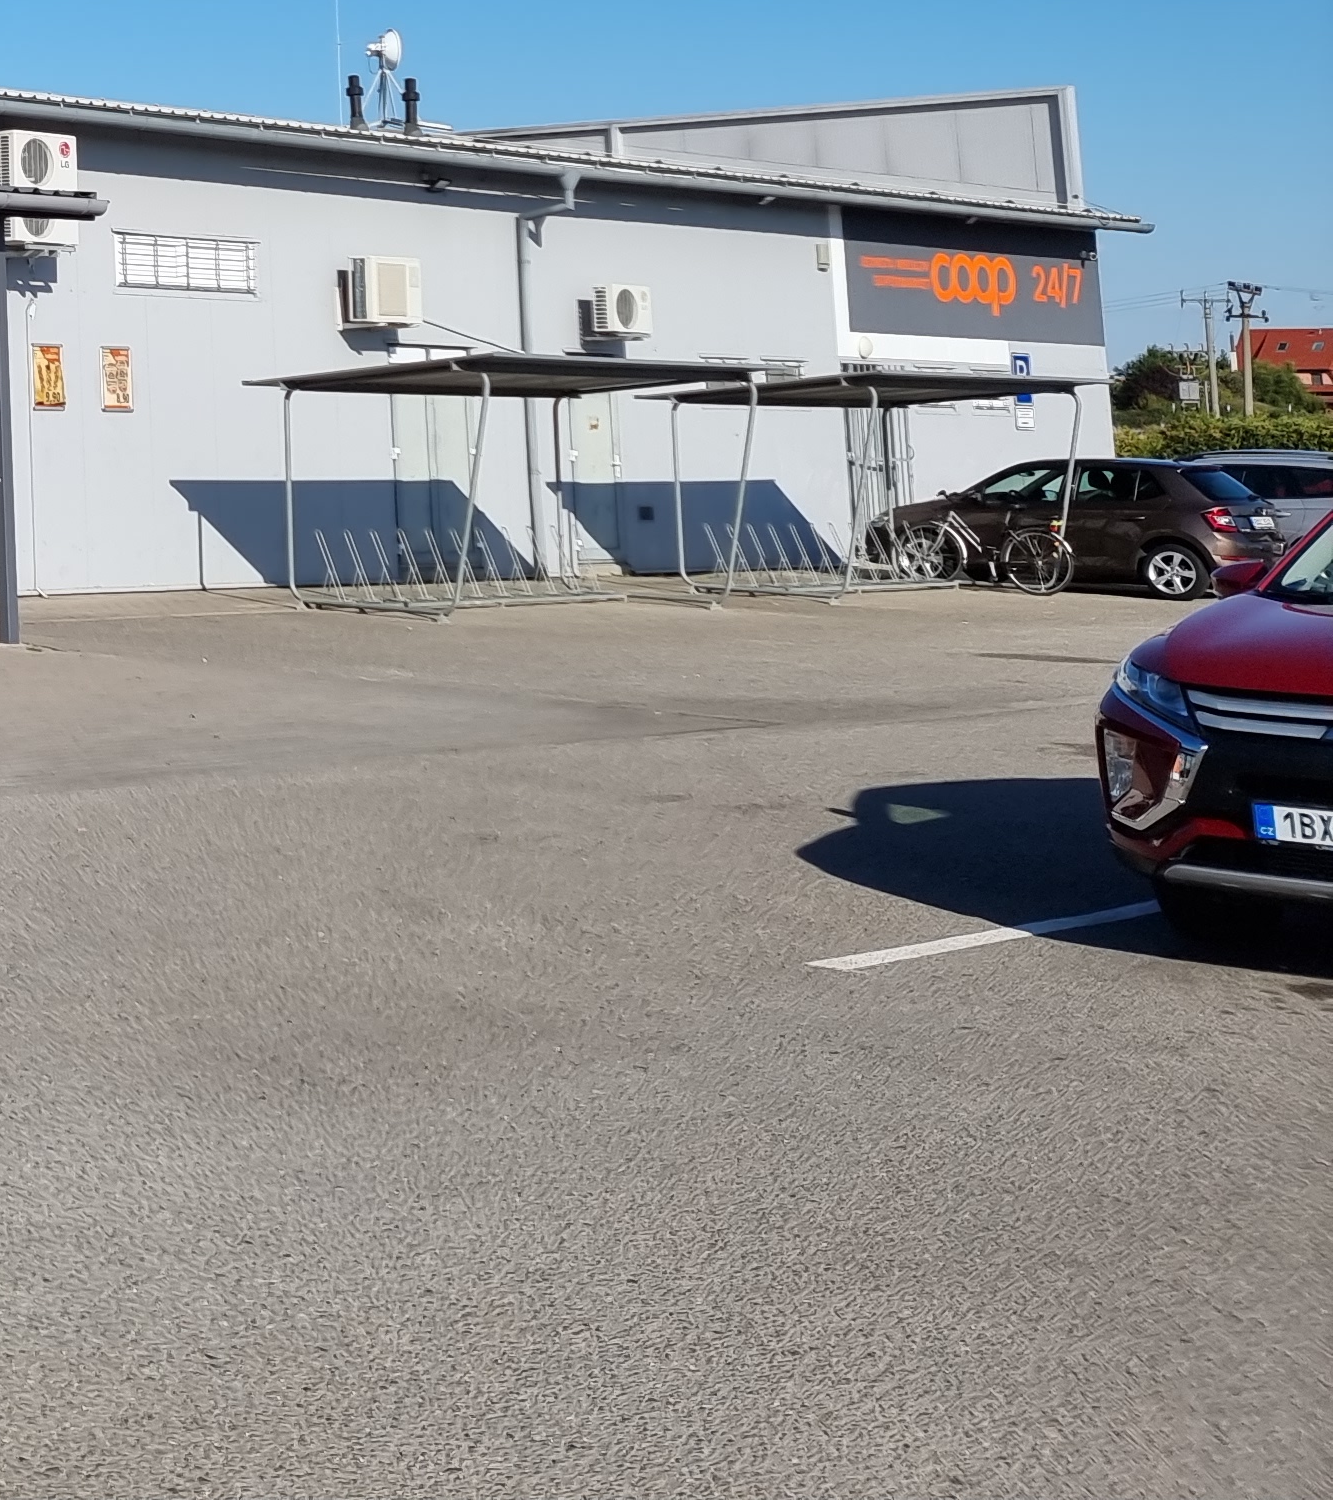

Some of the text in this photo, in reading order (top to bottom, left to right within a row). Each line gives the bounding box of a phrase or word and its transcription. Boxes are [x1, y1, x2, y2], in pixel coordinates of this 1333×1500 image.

[60, 160, 70, 169] LG
[931, 252, 1082, 317] coop 24/7
[1259, 826, 1275, 836] CZ
[1283, 811, 1333, 842] 1BX
